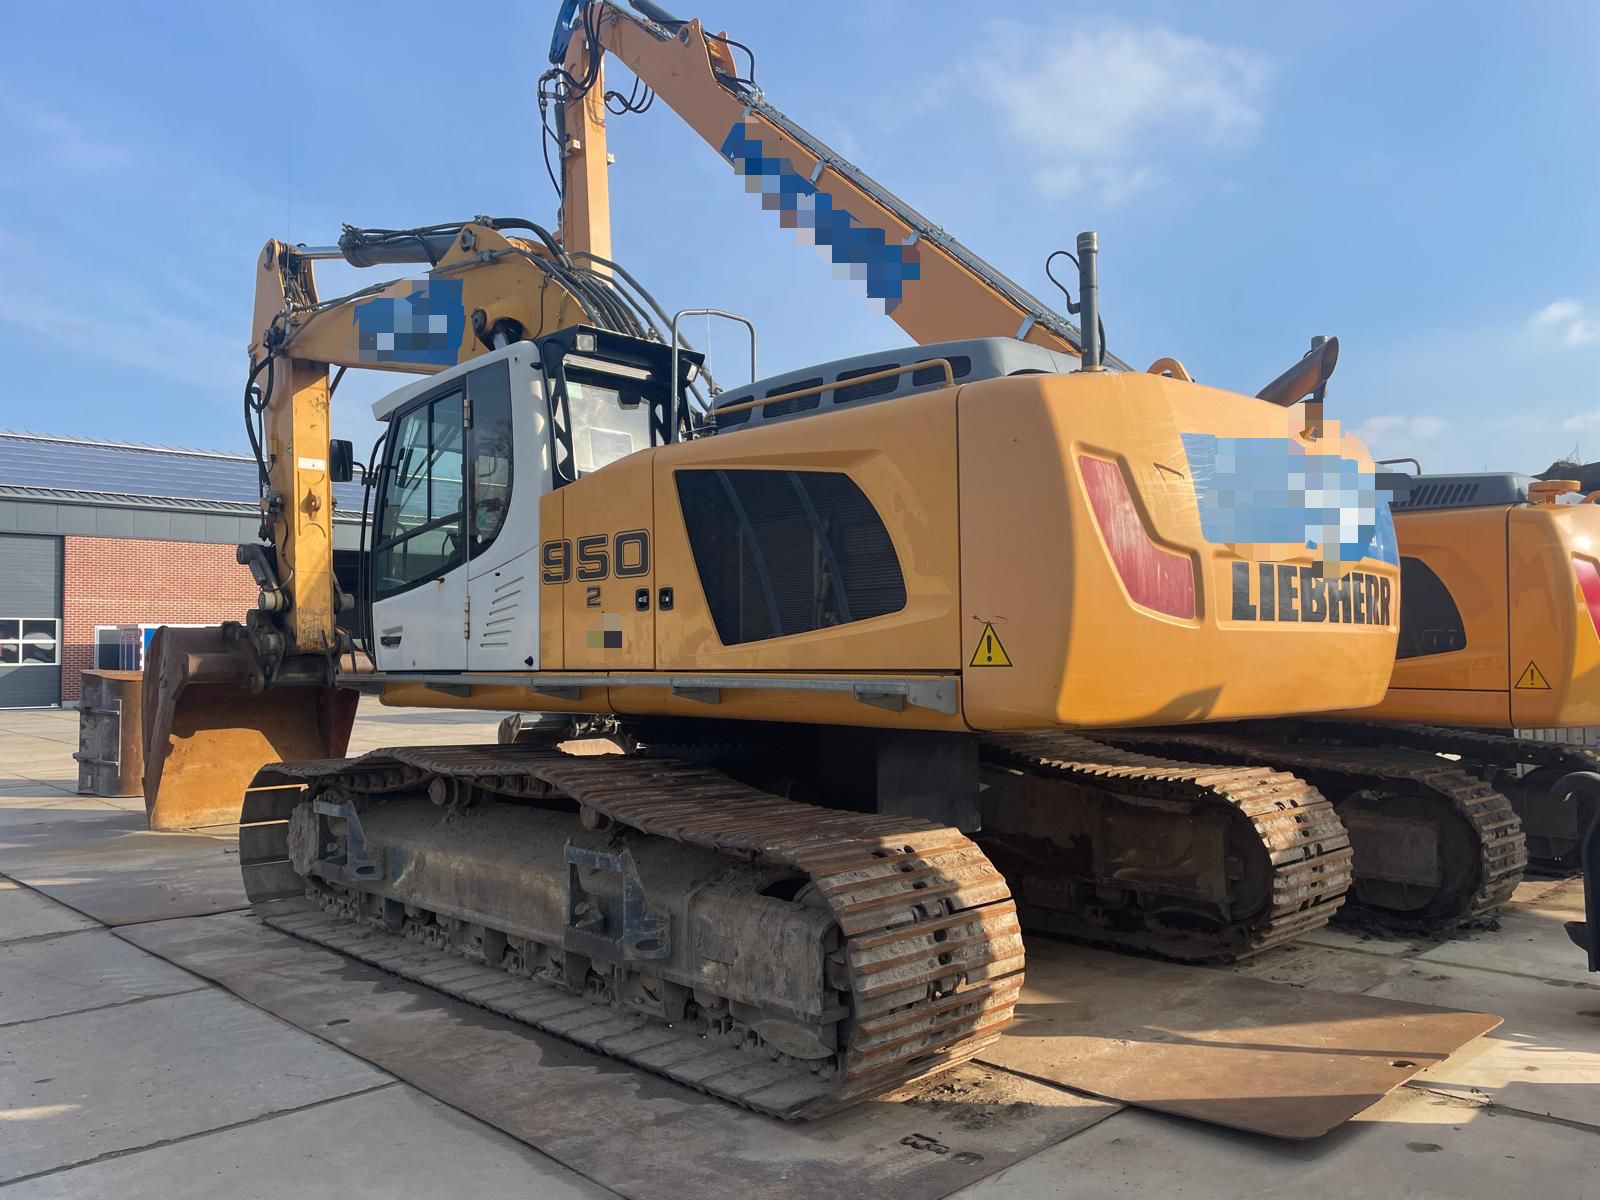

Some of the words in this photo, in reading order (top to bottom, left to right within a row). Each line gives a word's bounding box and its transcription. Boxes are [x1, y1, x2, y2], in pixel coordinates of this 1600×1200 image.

[542, 529, 650, 585] 950
[586, 585, 602, 608] 2
[1232, 562, 1391, 626] LIEBHERR
